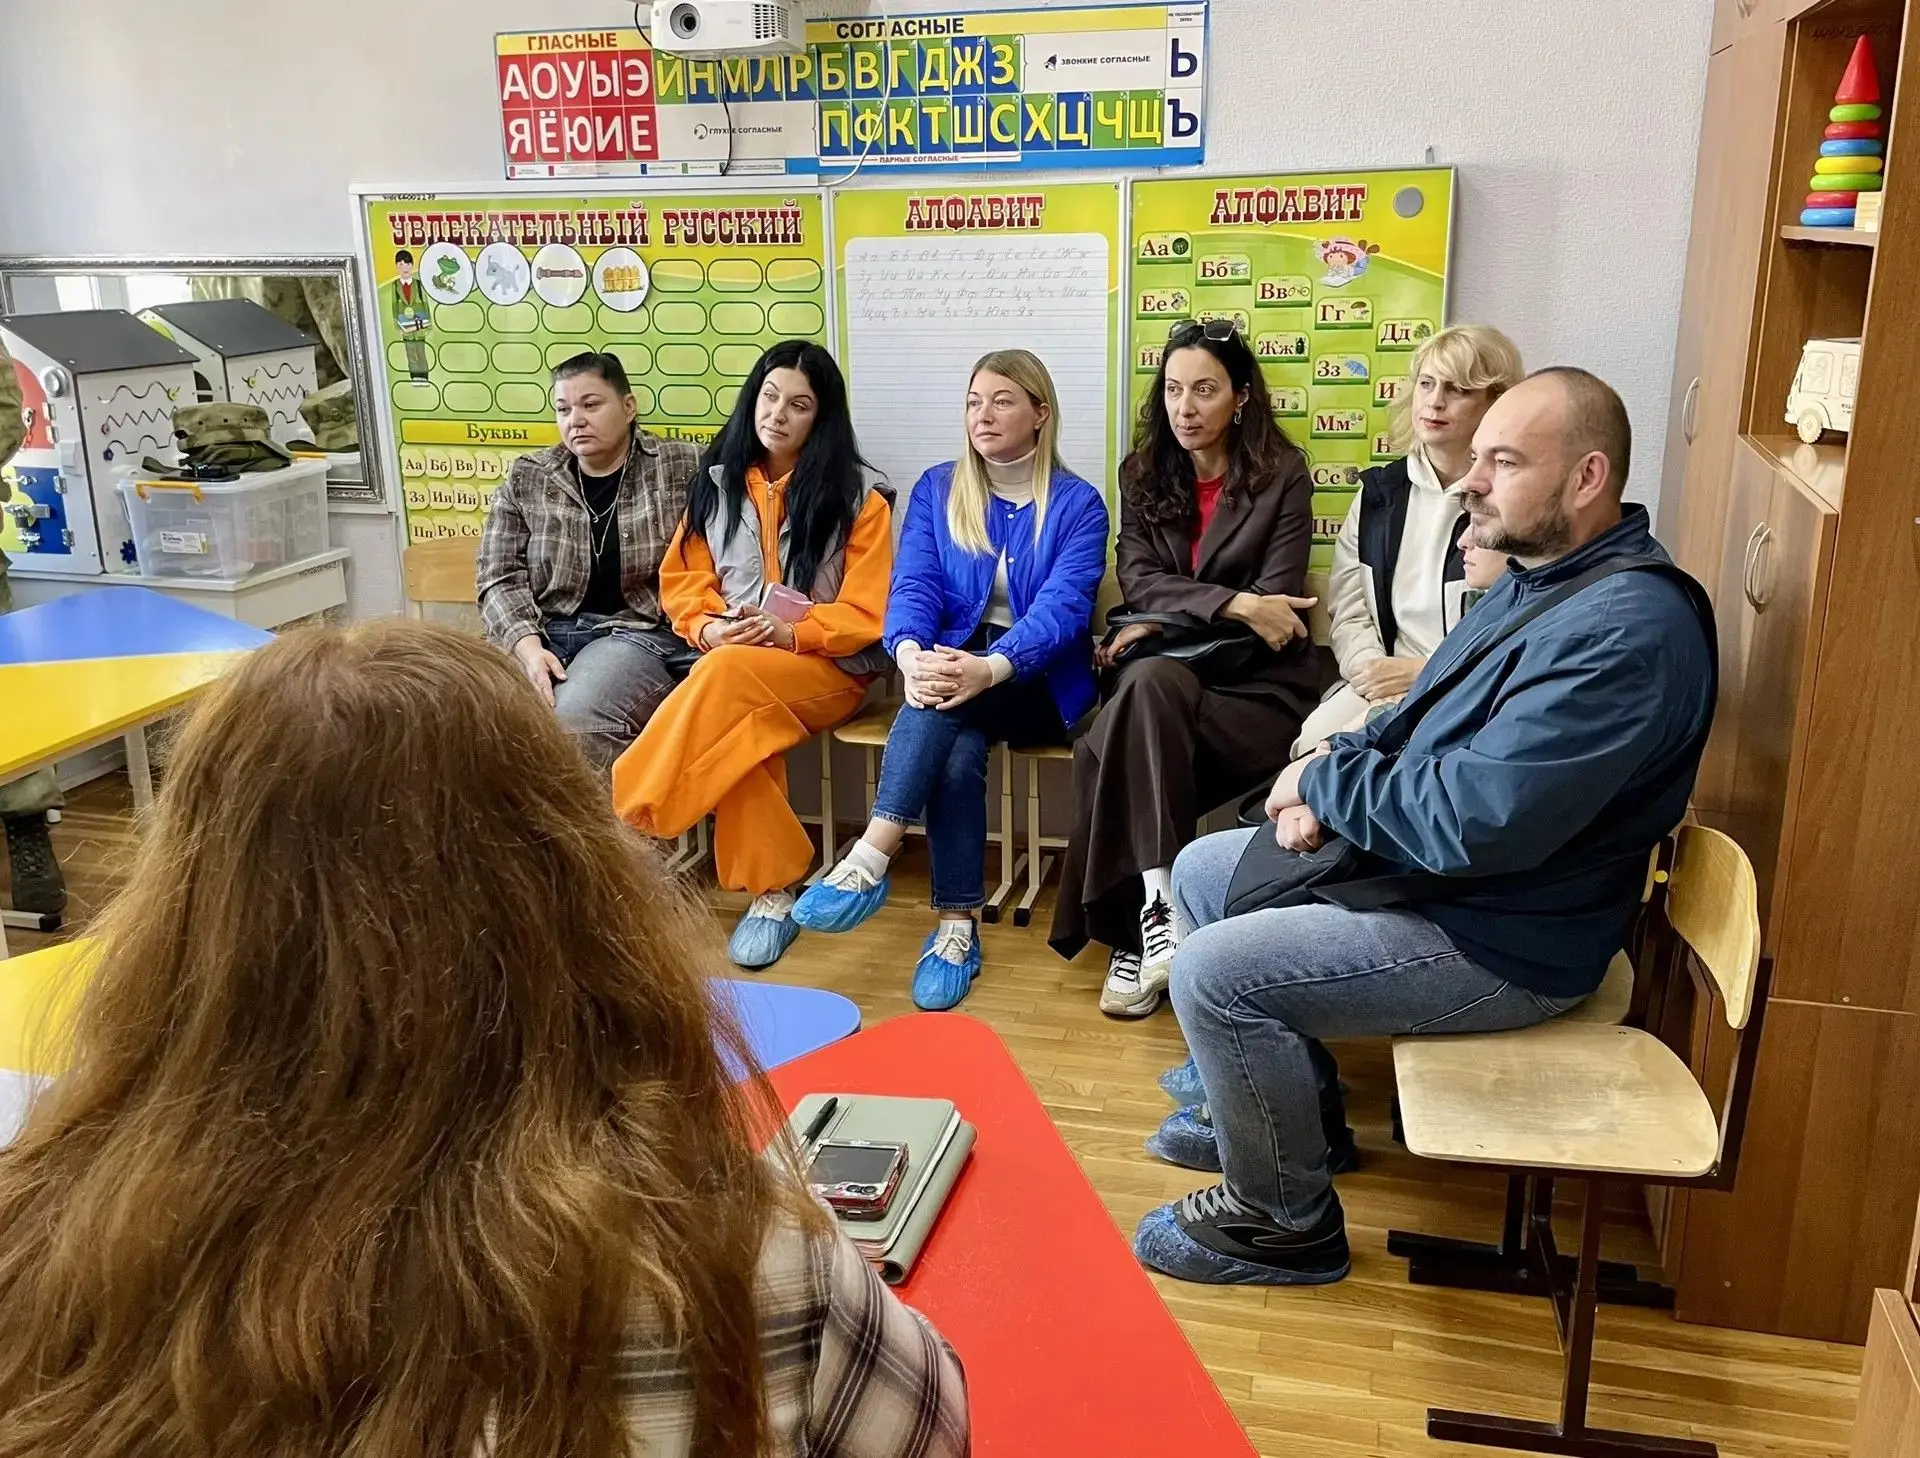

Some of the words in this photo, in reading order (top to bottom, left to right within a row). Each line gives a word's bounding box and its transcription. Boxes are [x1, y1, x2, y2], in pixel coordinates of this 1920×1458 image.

[836, 17, 964, 39] СОГЛАСНЫЕ
[527, 32, 618, 51] ГЛАСНЫЕ
[1100, 56, 1151, 64] СОГЛАСНЫЕ
[1170, 38, 1198, 78] Ь
[1167, 98, 1199, 138] Ъ
[905, 193, 1044, 232] АЛФАВИТ
[1210, 184, 1367, 226] АЛФАВИТ
[388, 203, 650, 248] УВЛЕКАТЕЛЬНЫЙ
[663, 199, 804, 247] РУССКИЙ
[1141, 240, 1169, 256] Аа
[1201, 261, 1228, 278] Бб
[1260, 283, 1288, 300] Вв
[1142, 295, 1167, 312] Ее
[1320, 304, 1346, 321] Гг
[1381, 323, 1410, 344] Дд
[1258, 340, 1294, 355] Жж
[1317, 360, 1340, 377] Зз
[1315, 415, 1351, 431] Мм
[466, 423, 528, 442] Буквы
[405, 459, 423, 471] Аа
[431, 459, 448, 472] Бб
[456, 460, 473, 471] Вв
[481, 460, 497, 473] Гг
[1314, 468, 1340, 485] Сс
[409, 491, 425, 503] Зз
[433, 491, 452, 503] Ии
[457, 489, 477, 505] Йй
[414, 526, 435, 538] Пп
[438, 526, 456, 538] Рр
[461, 525, 479, 536] Сс
